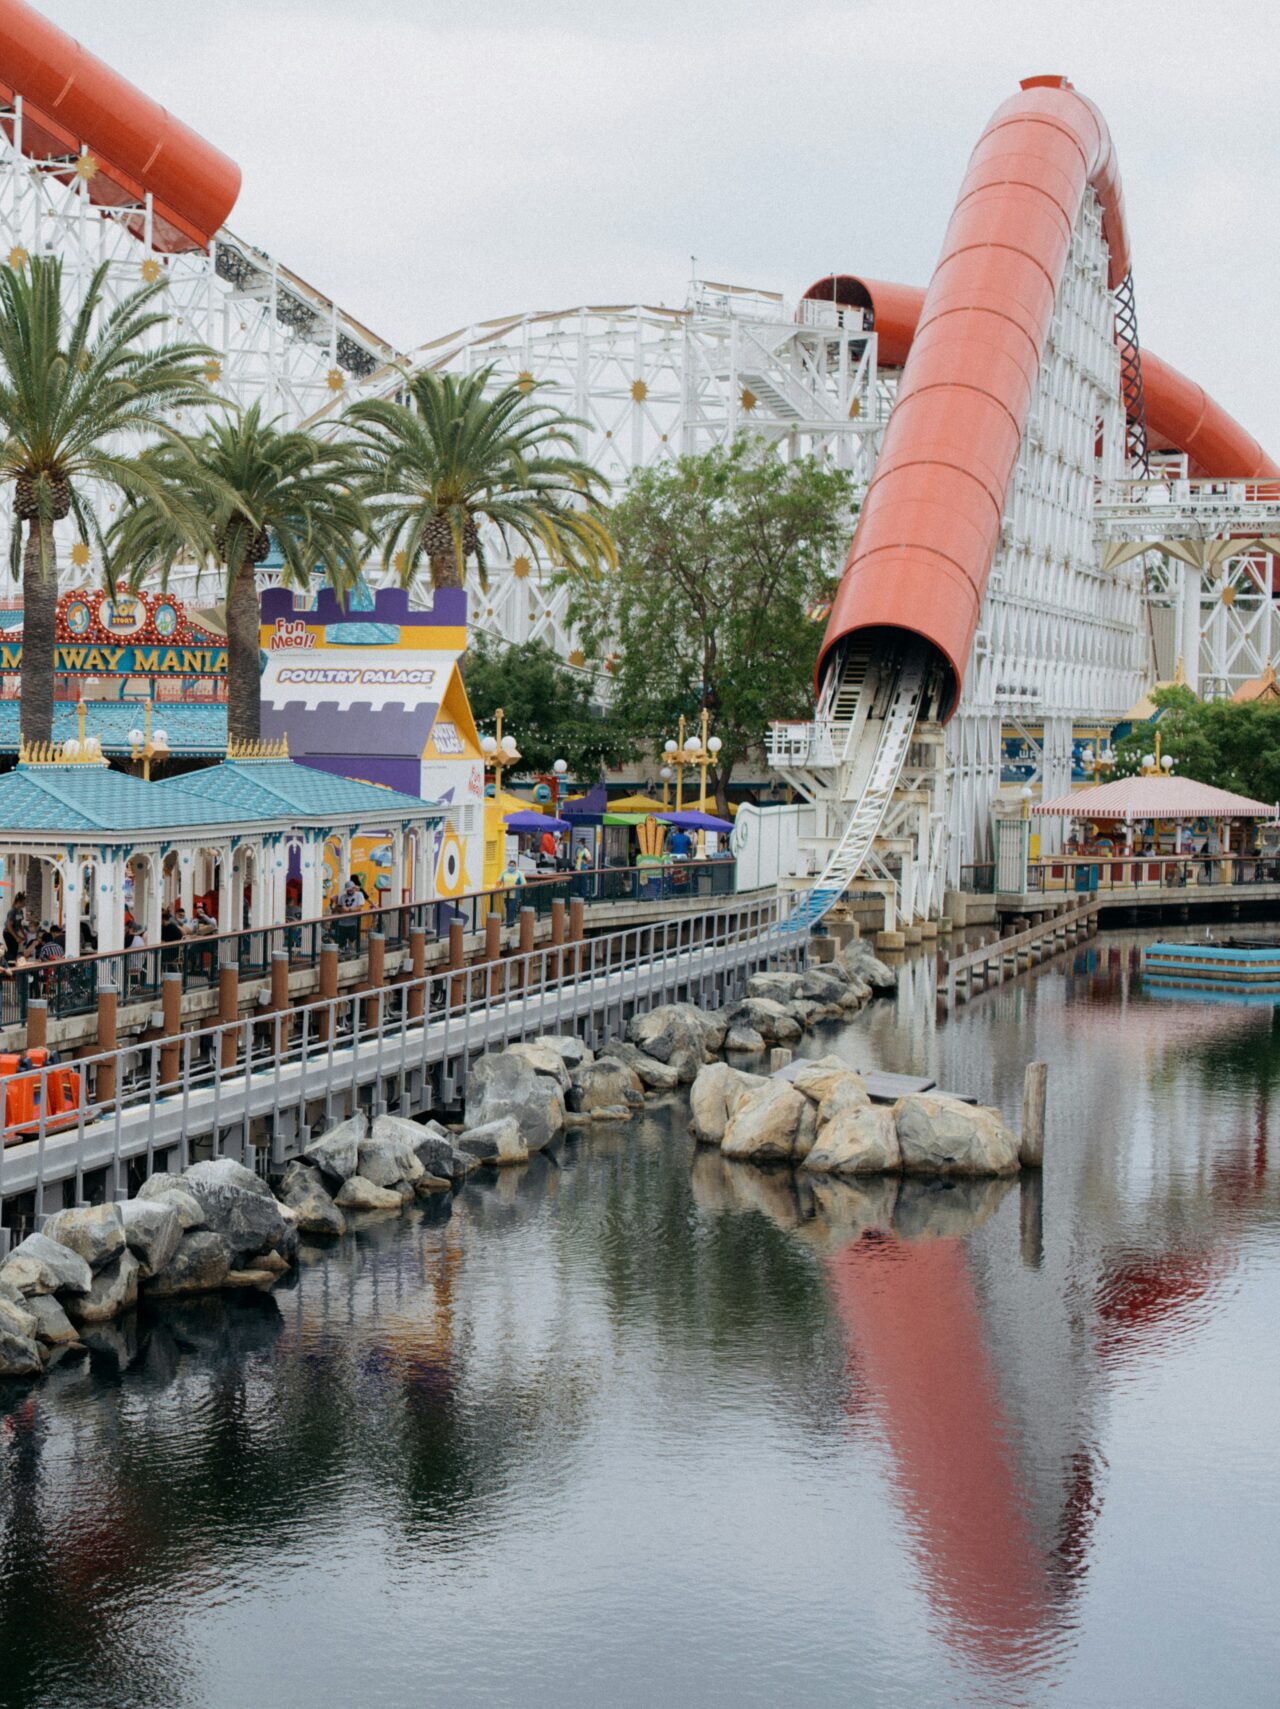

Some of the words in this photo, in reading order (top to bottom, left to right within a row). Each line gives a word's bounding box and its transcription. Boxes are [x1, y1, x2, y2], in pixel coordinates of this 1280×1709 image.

[111, 616, 135, 625] STORY
[276, 618, 306, 635] Fun
[270, 633, 316, 651] Meal!
[1, 647, 123, 670] MWAY
[277, 669, 359, 684] POULTRY
[361, 669, 434, 685] PALACE
